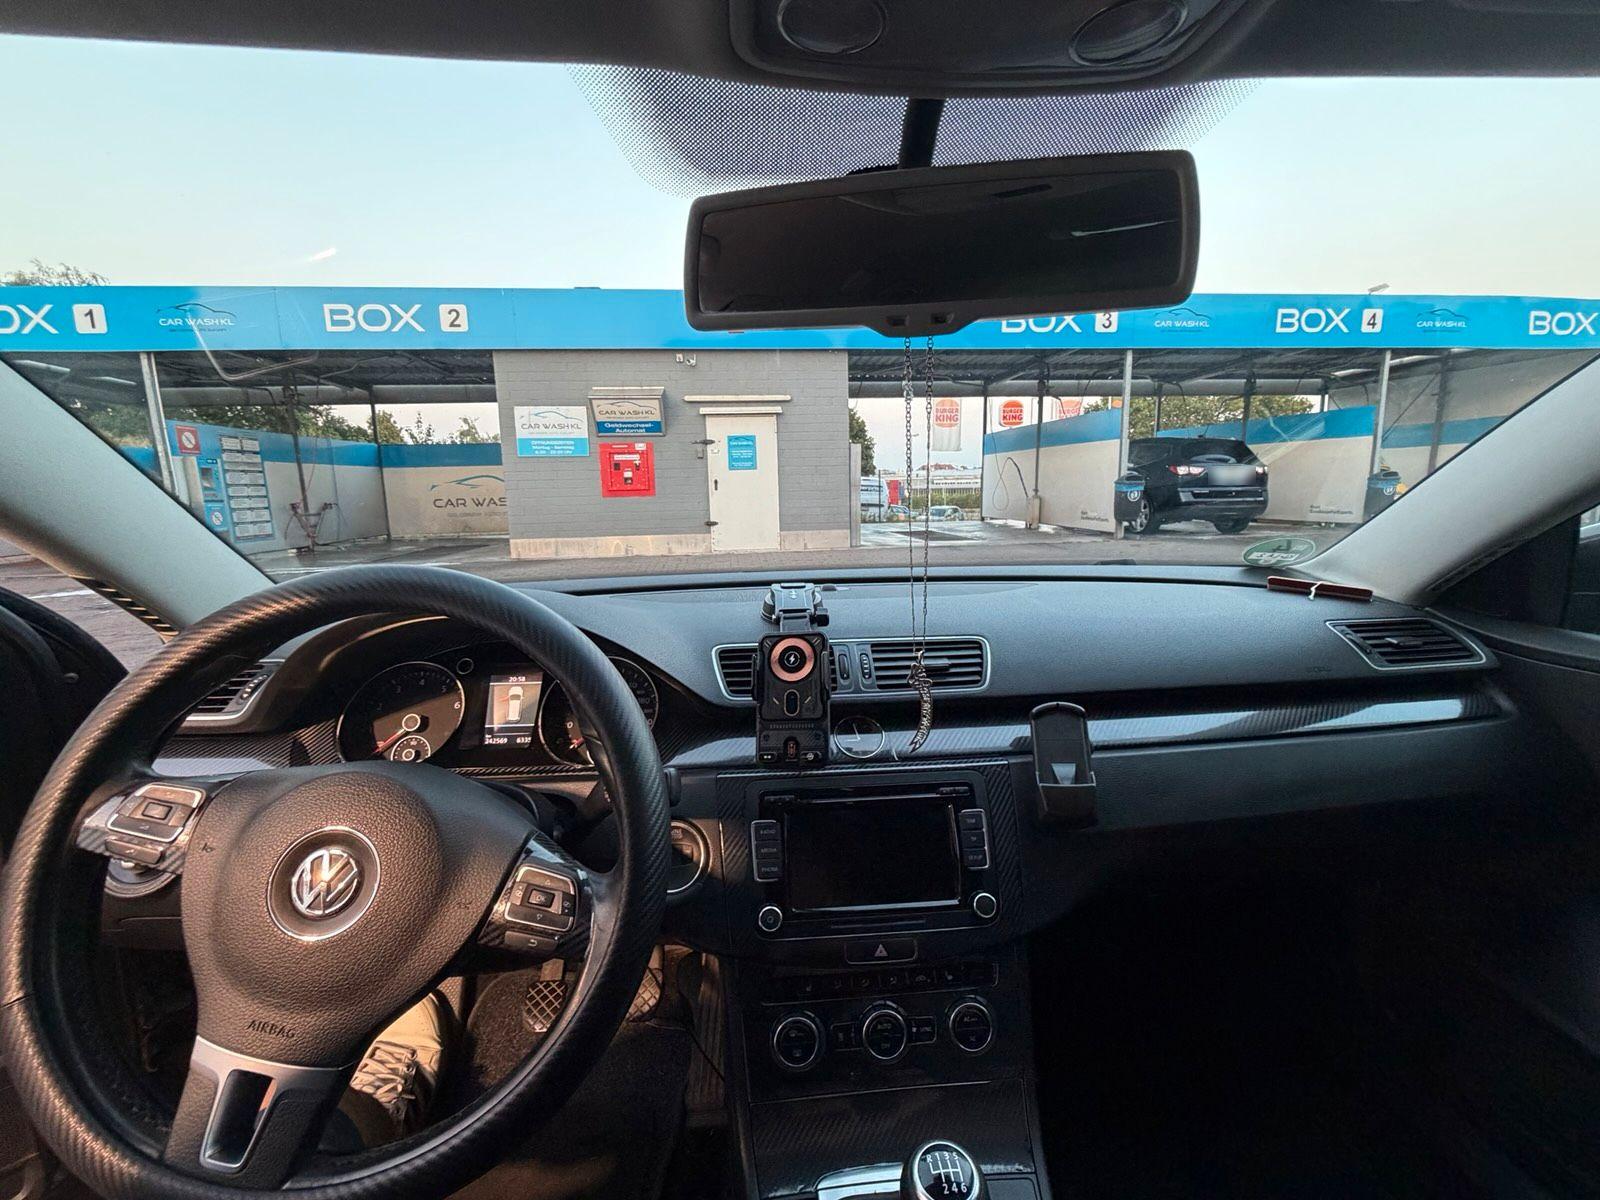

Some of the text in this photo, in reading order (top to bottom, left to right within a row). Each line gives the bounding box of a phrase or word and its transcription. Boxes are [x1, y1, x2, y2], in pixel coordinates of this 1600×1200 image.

[0, 304, 95, 334] X 1
[158, 318, 183, 326] CAR
[323, 304, 462, 332] BOX 2
[1100, 312, 1112, 329] 3
[1154, 320, 1173, 328] CAR
[1275, 308, 1378, 333] BOX 4
[1416, 320, 1433, 328] CAR
[1528, 311, 1600, 335] BOX
[935, 413, 959, 422] KING
[1002, 413, 1023, 421] KING
[433, 496, 508, 508] CAR WAS
[453, 701, 461, 709] 6
[247, 1020, 297, 1039] AIRBAG
[926, 1152, 959, 1163] R 1 3 5
[942, 1182, 968, 1195] 2 4 6
